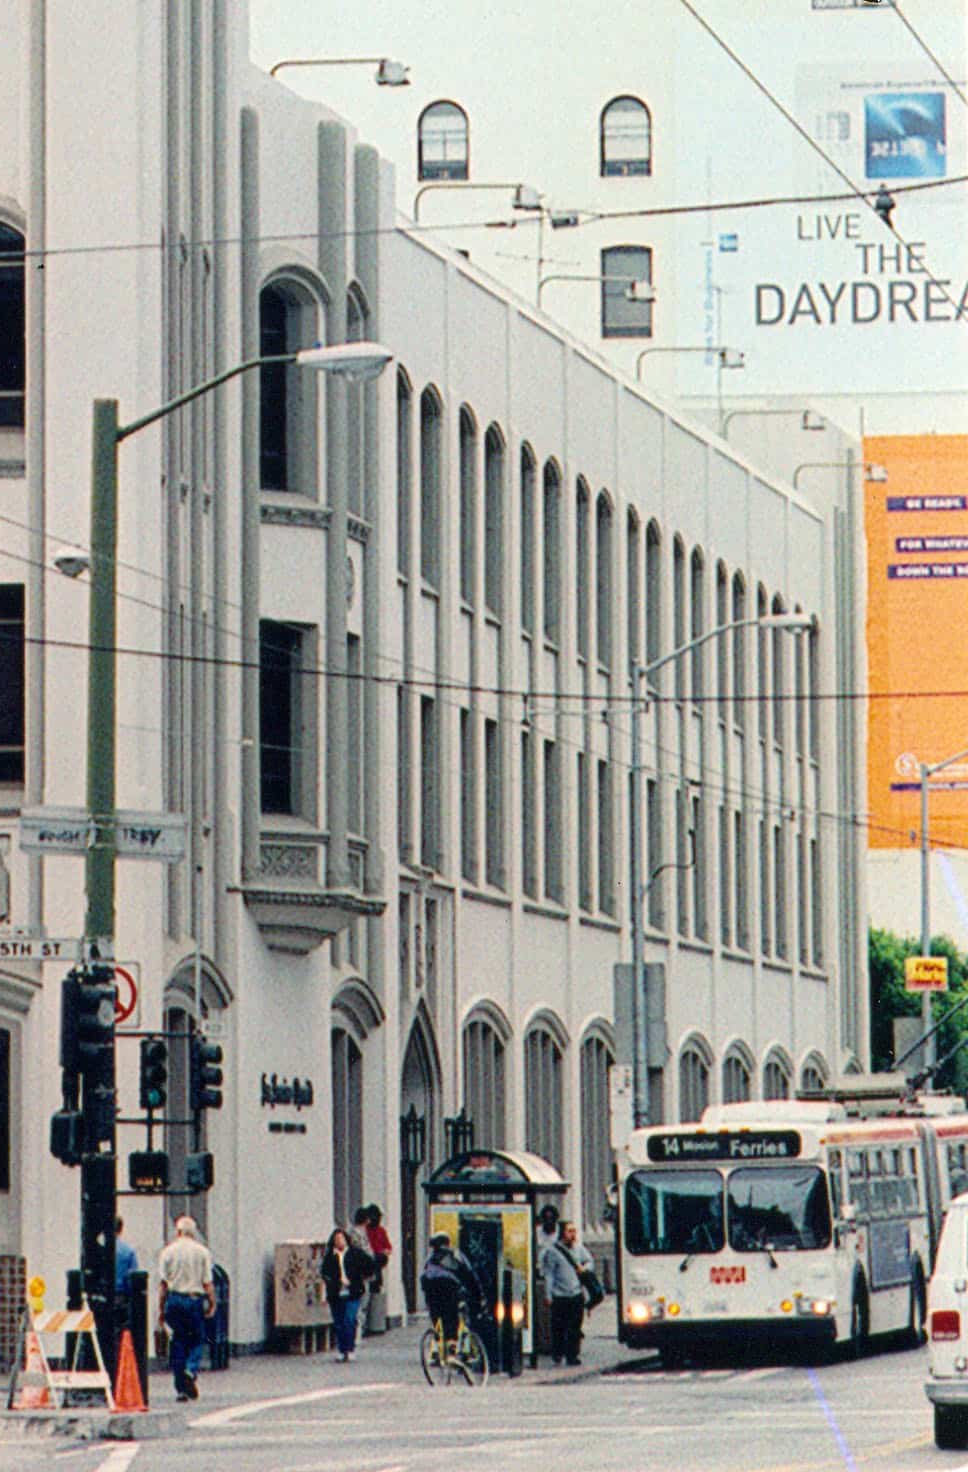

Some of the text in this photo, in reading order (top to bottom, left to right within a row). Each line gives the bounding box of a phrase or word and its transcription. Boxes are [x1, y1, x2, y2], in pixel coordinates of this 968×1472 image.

[797, 213, 861, 240] LIVE
[855, 242, 926, 274] THE
[0, 942, 61, 957] 5TH ST
[662, 1138, 680, 1156] 14
[730, 1138, 788, 1156] Ferries
